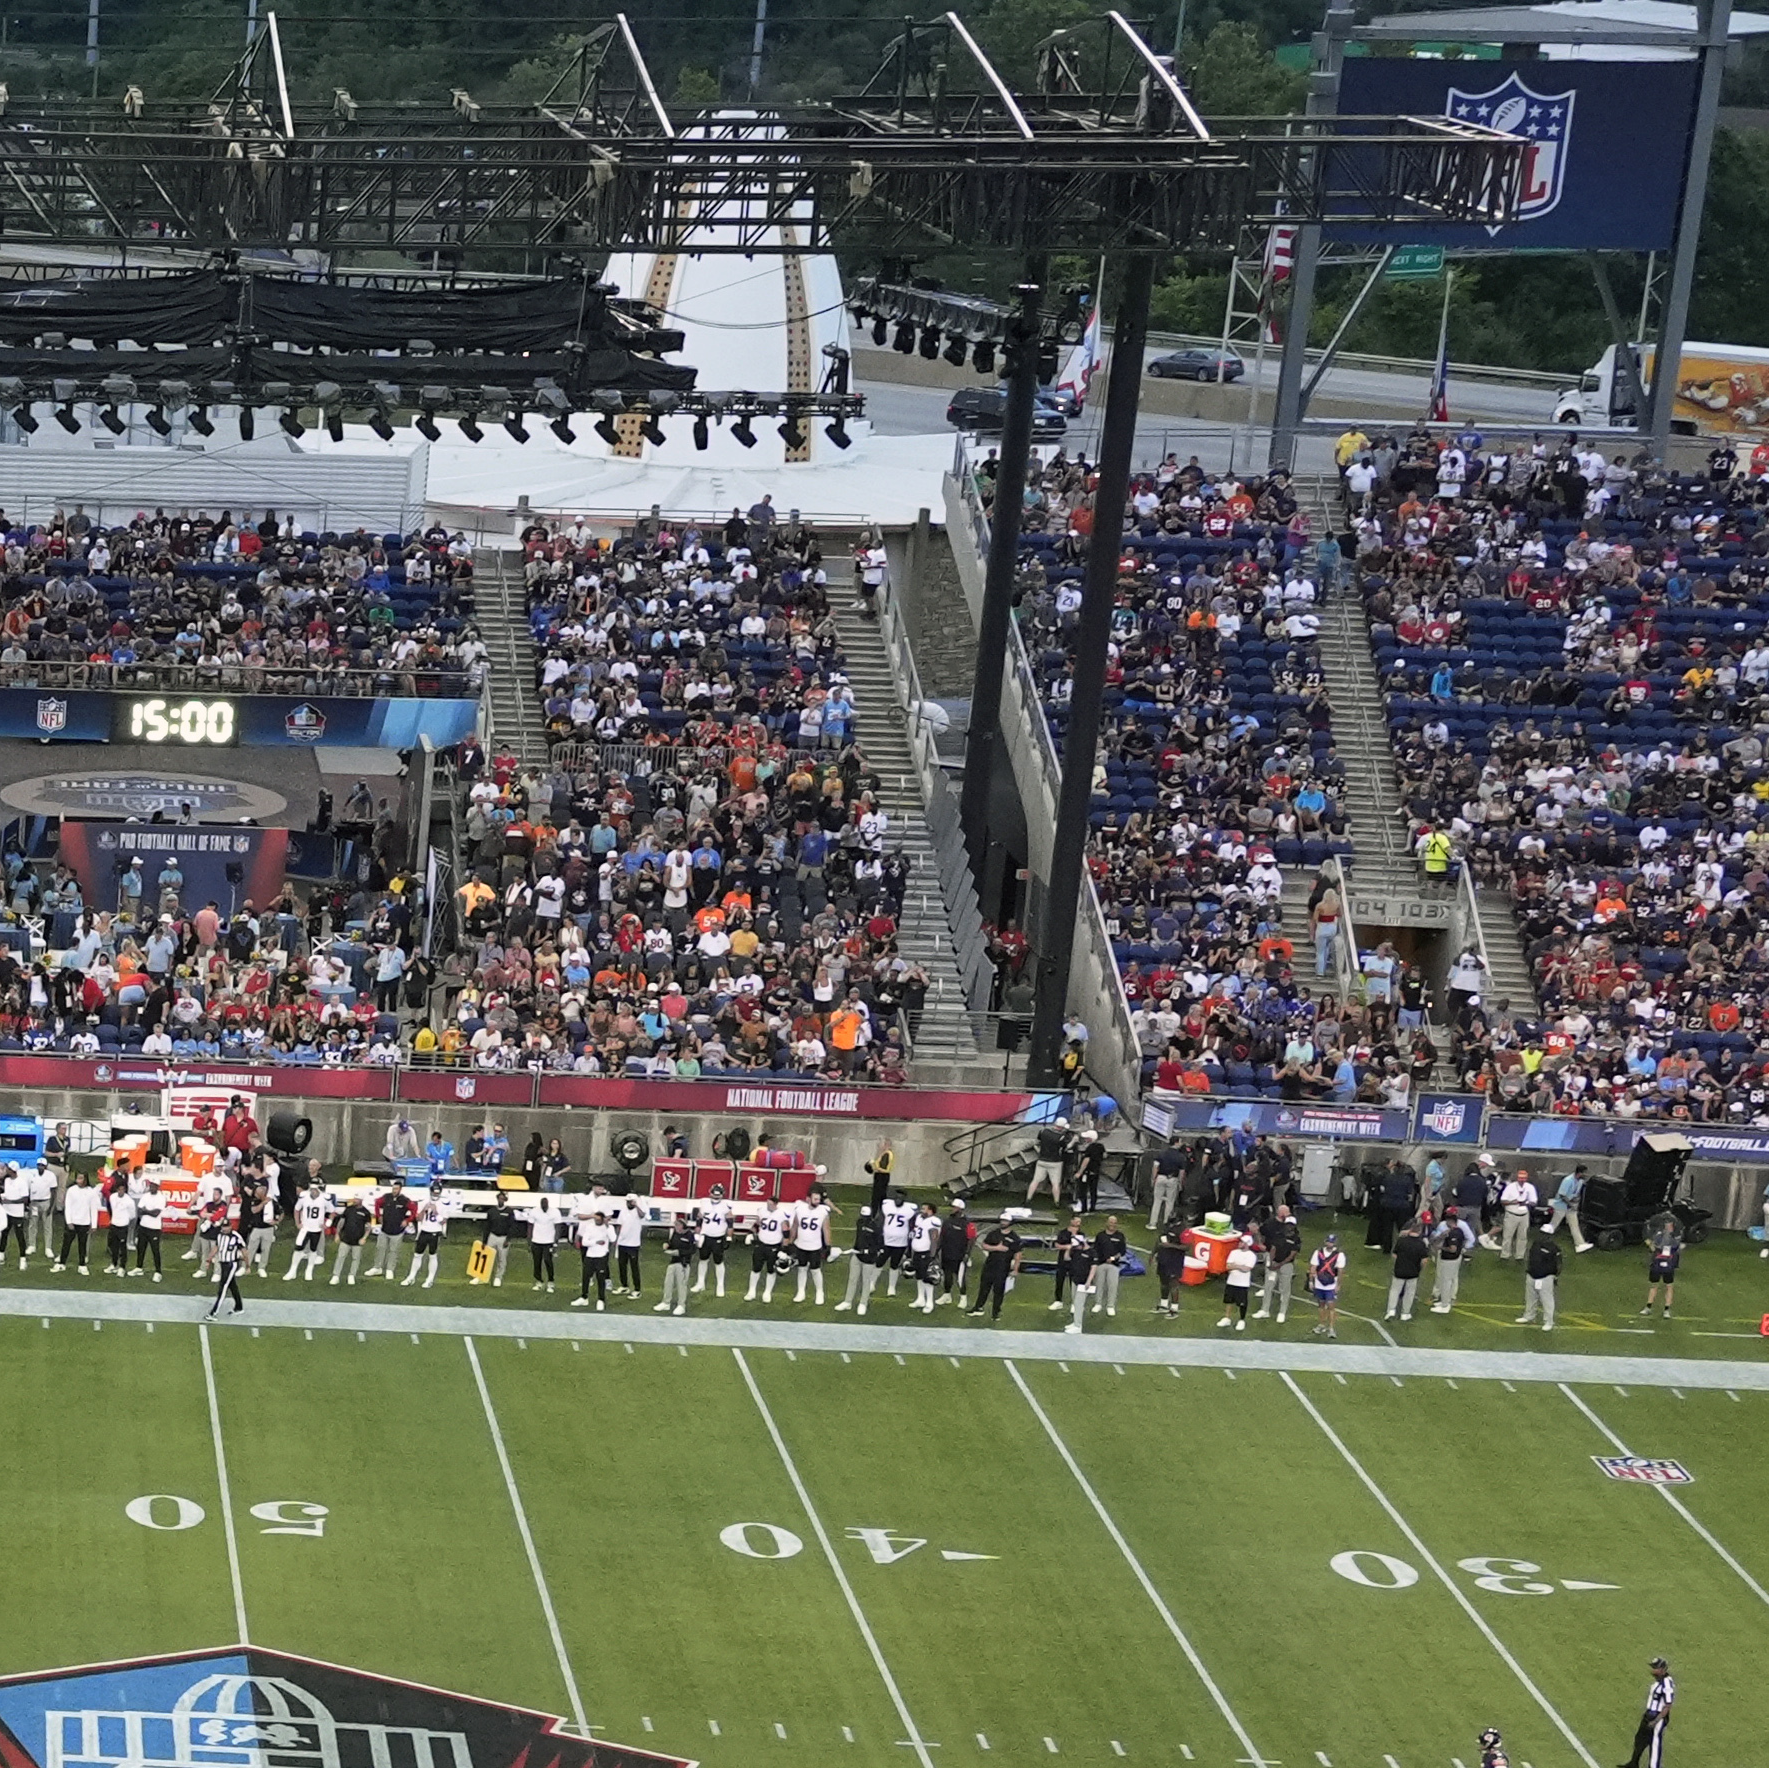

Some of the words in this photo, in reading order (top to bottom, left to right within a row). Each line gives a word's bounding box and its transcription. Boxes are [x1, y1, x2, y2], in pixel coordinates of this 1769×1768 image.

[41, 712, 62, 727] NFL
[131, 700, 234, 743] 15:00
[120, 833, 136, 849] PRO
[137, 833, 175, 850] FOOTBALL
[177, 834, 197, 851] HALL
[198, 835, 209, 851] OF
[210, 835, 231, 852] FAME
[1401, 903, 1438, 918] 103
[726, 1088, 773, 1108] NATIONAL
[775, 1090, 821, 1110] FOOTBALL
[823, 1092, 859, 1112] LEAGUE
[1300, 1118, 1357, 1134] ENSHRINEMENT
[1359, 1122, 1381, 1135] WEEK
[1437, 1116, 1457, 1131] NFL
[306, 1207, 320, 1219] 18
[703, 1213, 720, 1225] 54
[887, 1213, 905, 1227] 75
[800, 1217, 818, 1230] 66
[473, 1252, 489, 1272] 11
[1610, 1468, 1683, 1480] NFL
